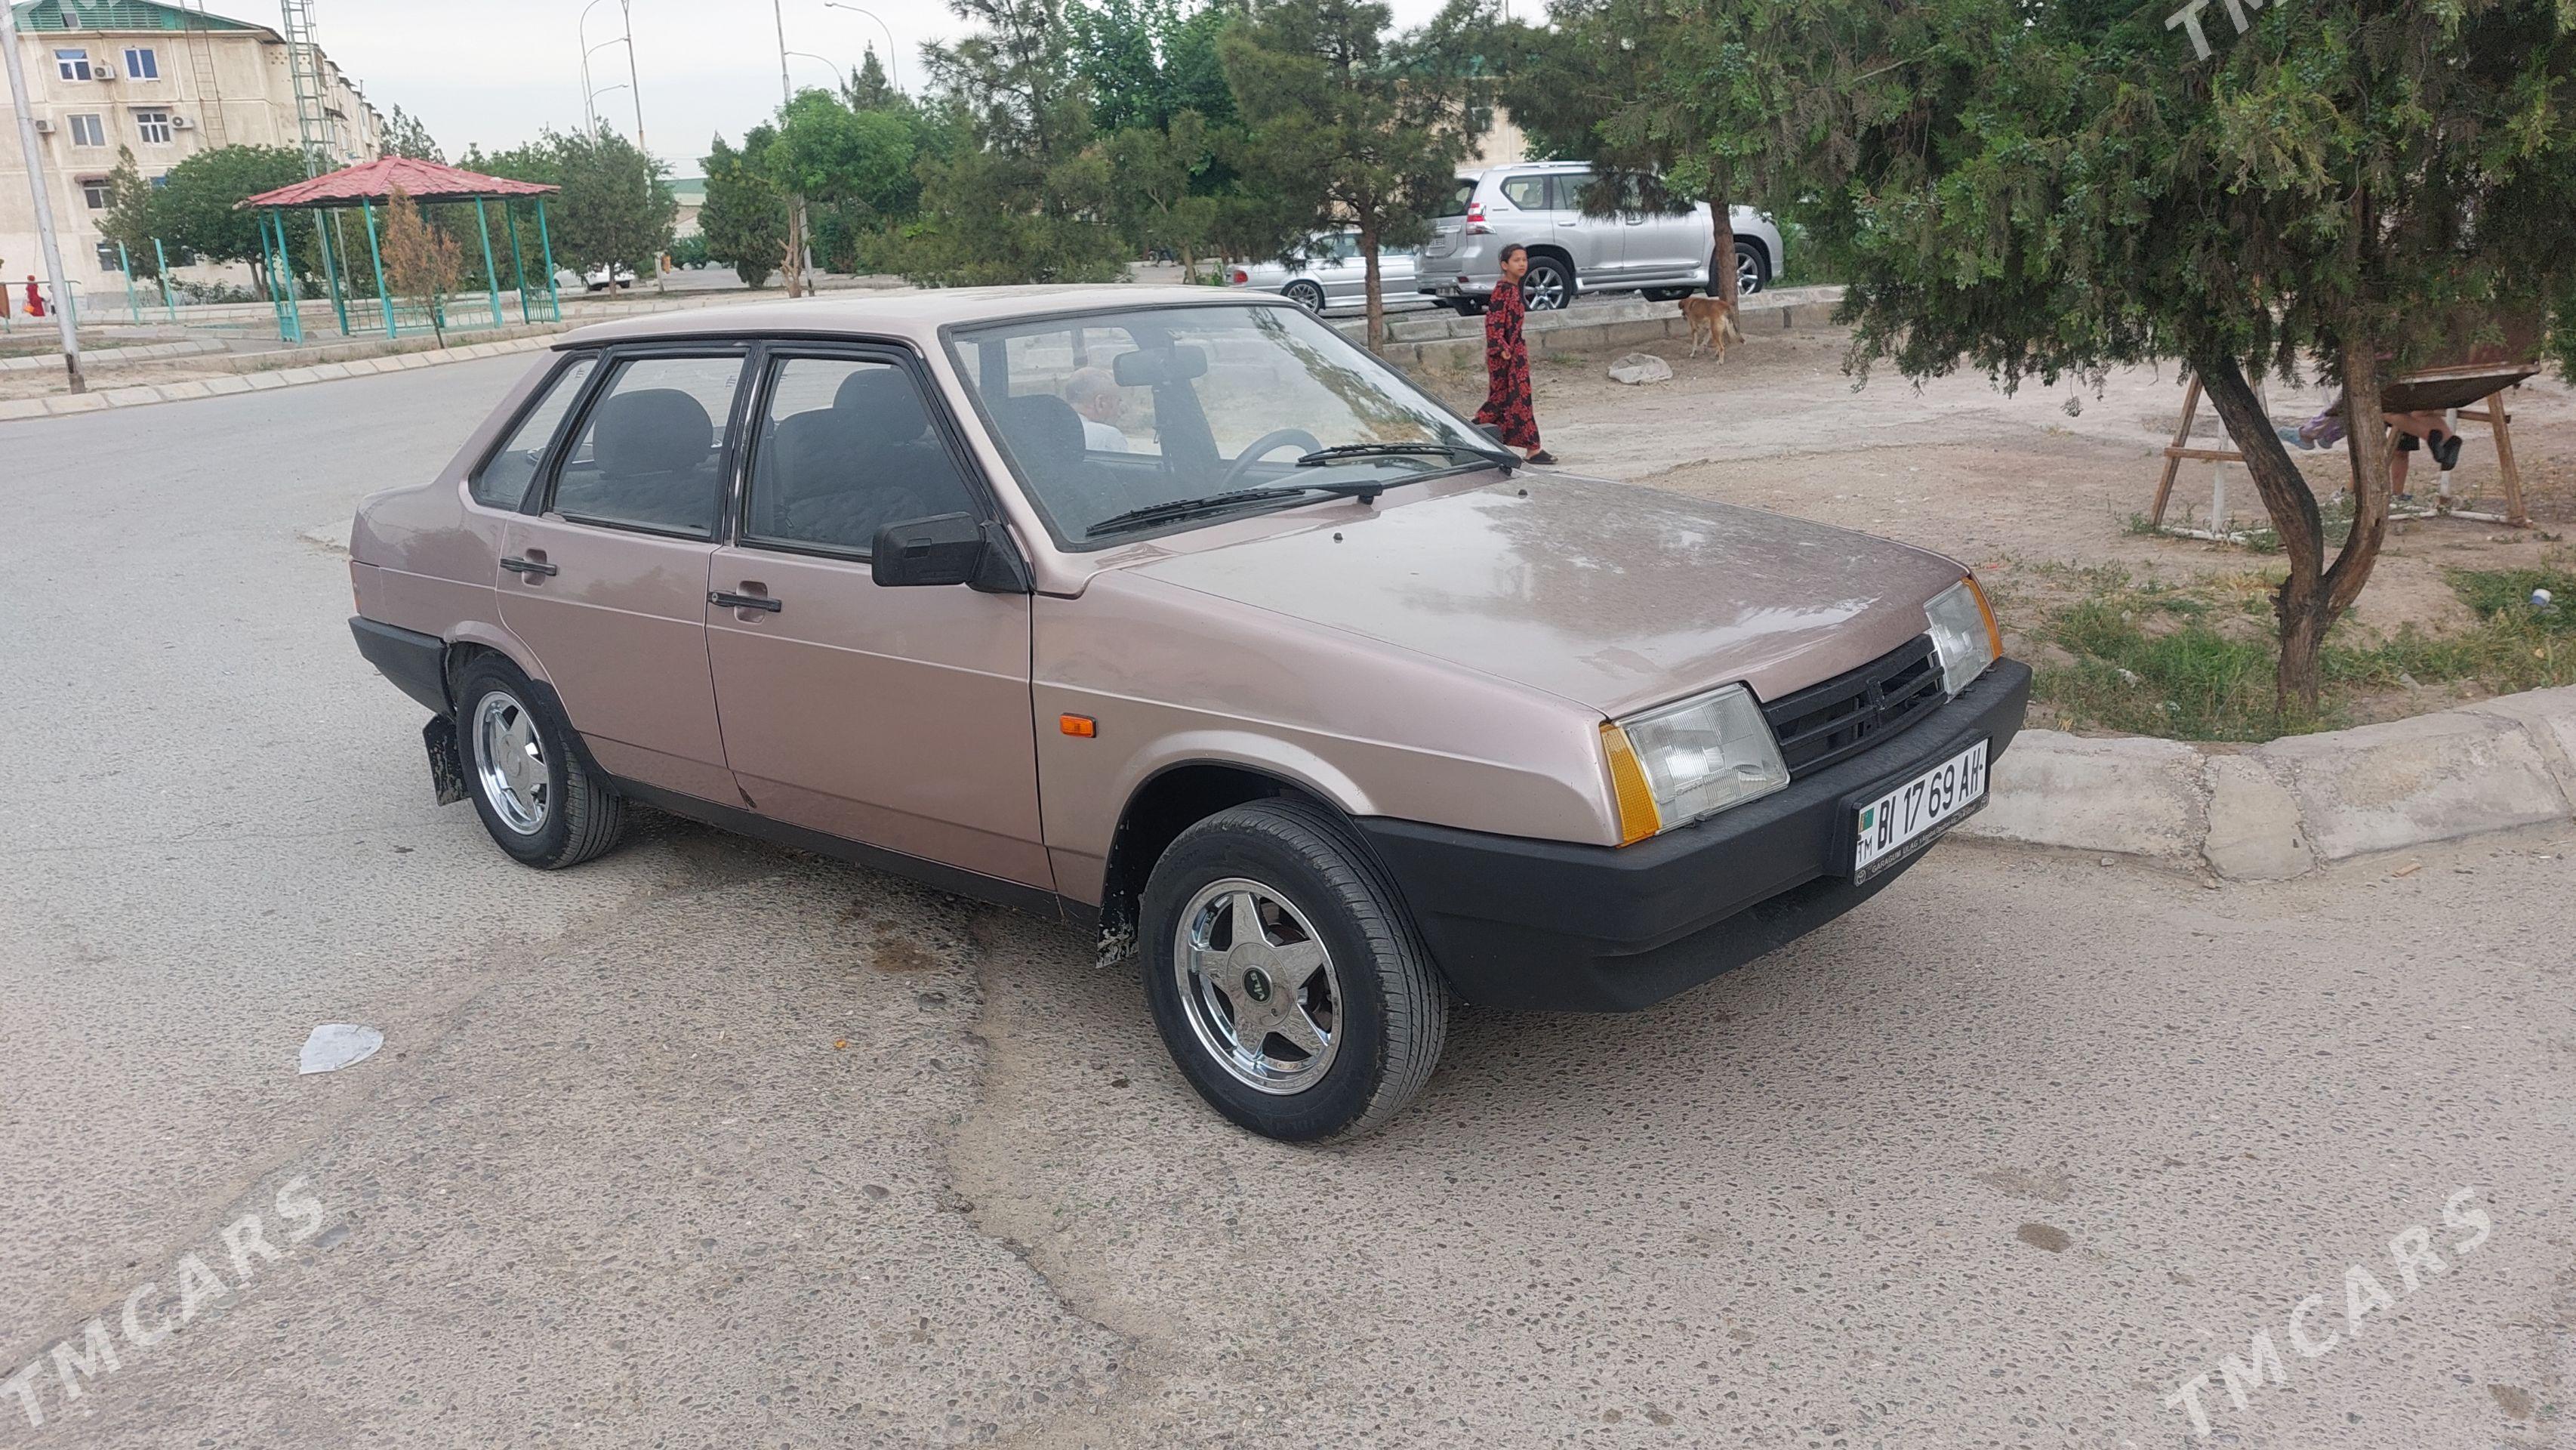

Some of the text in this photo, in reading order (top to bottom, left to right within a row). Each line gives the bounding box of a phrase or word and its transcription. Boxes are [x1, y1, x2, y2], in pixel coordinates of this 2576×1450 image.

[1877, 795, 1896, 850] BI
[1903, 779, 1925, 835] 17
[1928, 764, 1955, 818] 69
[1958, 747, 1980, 802] AH
[1857, 834, 1872, 862] TM
